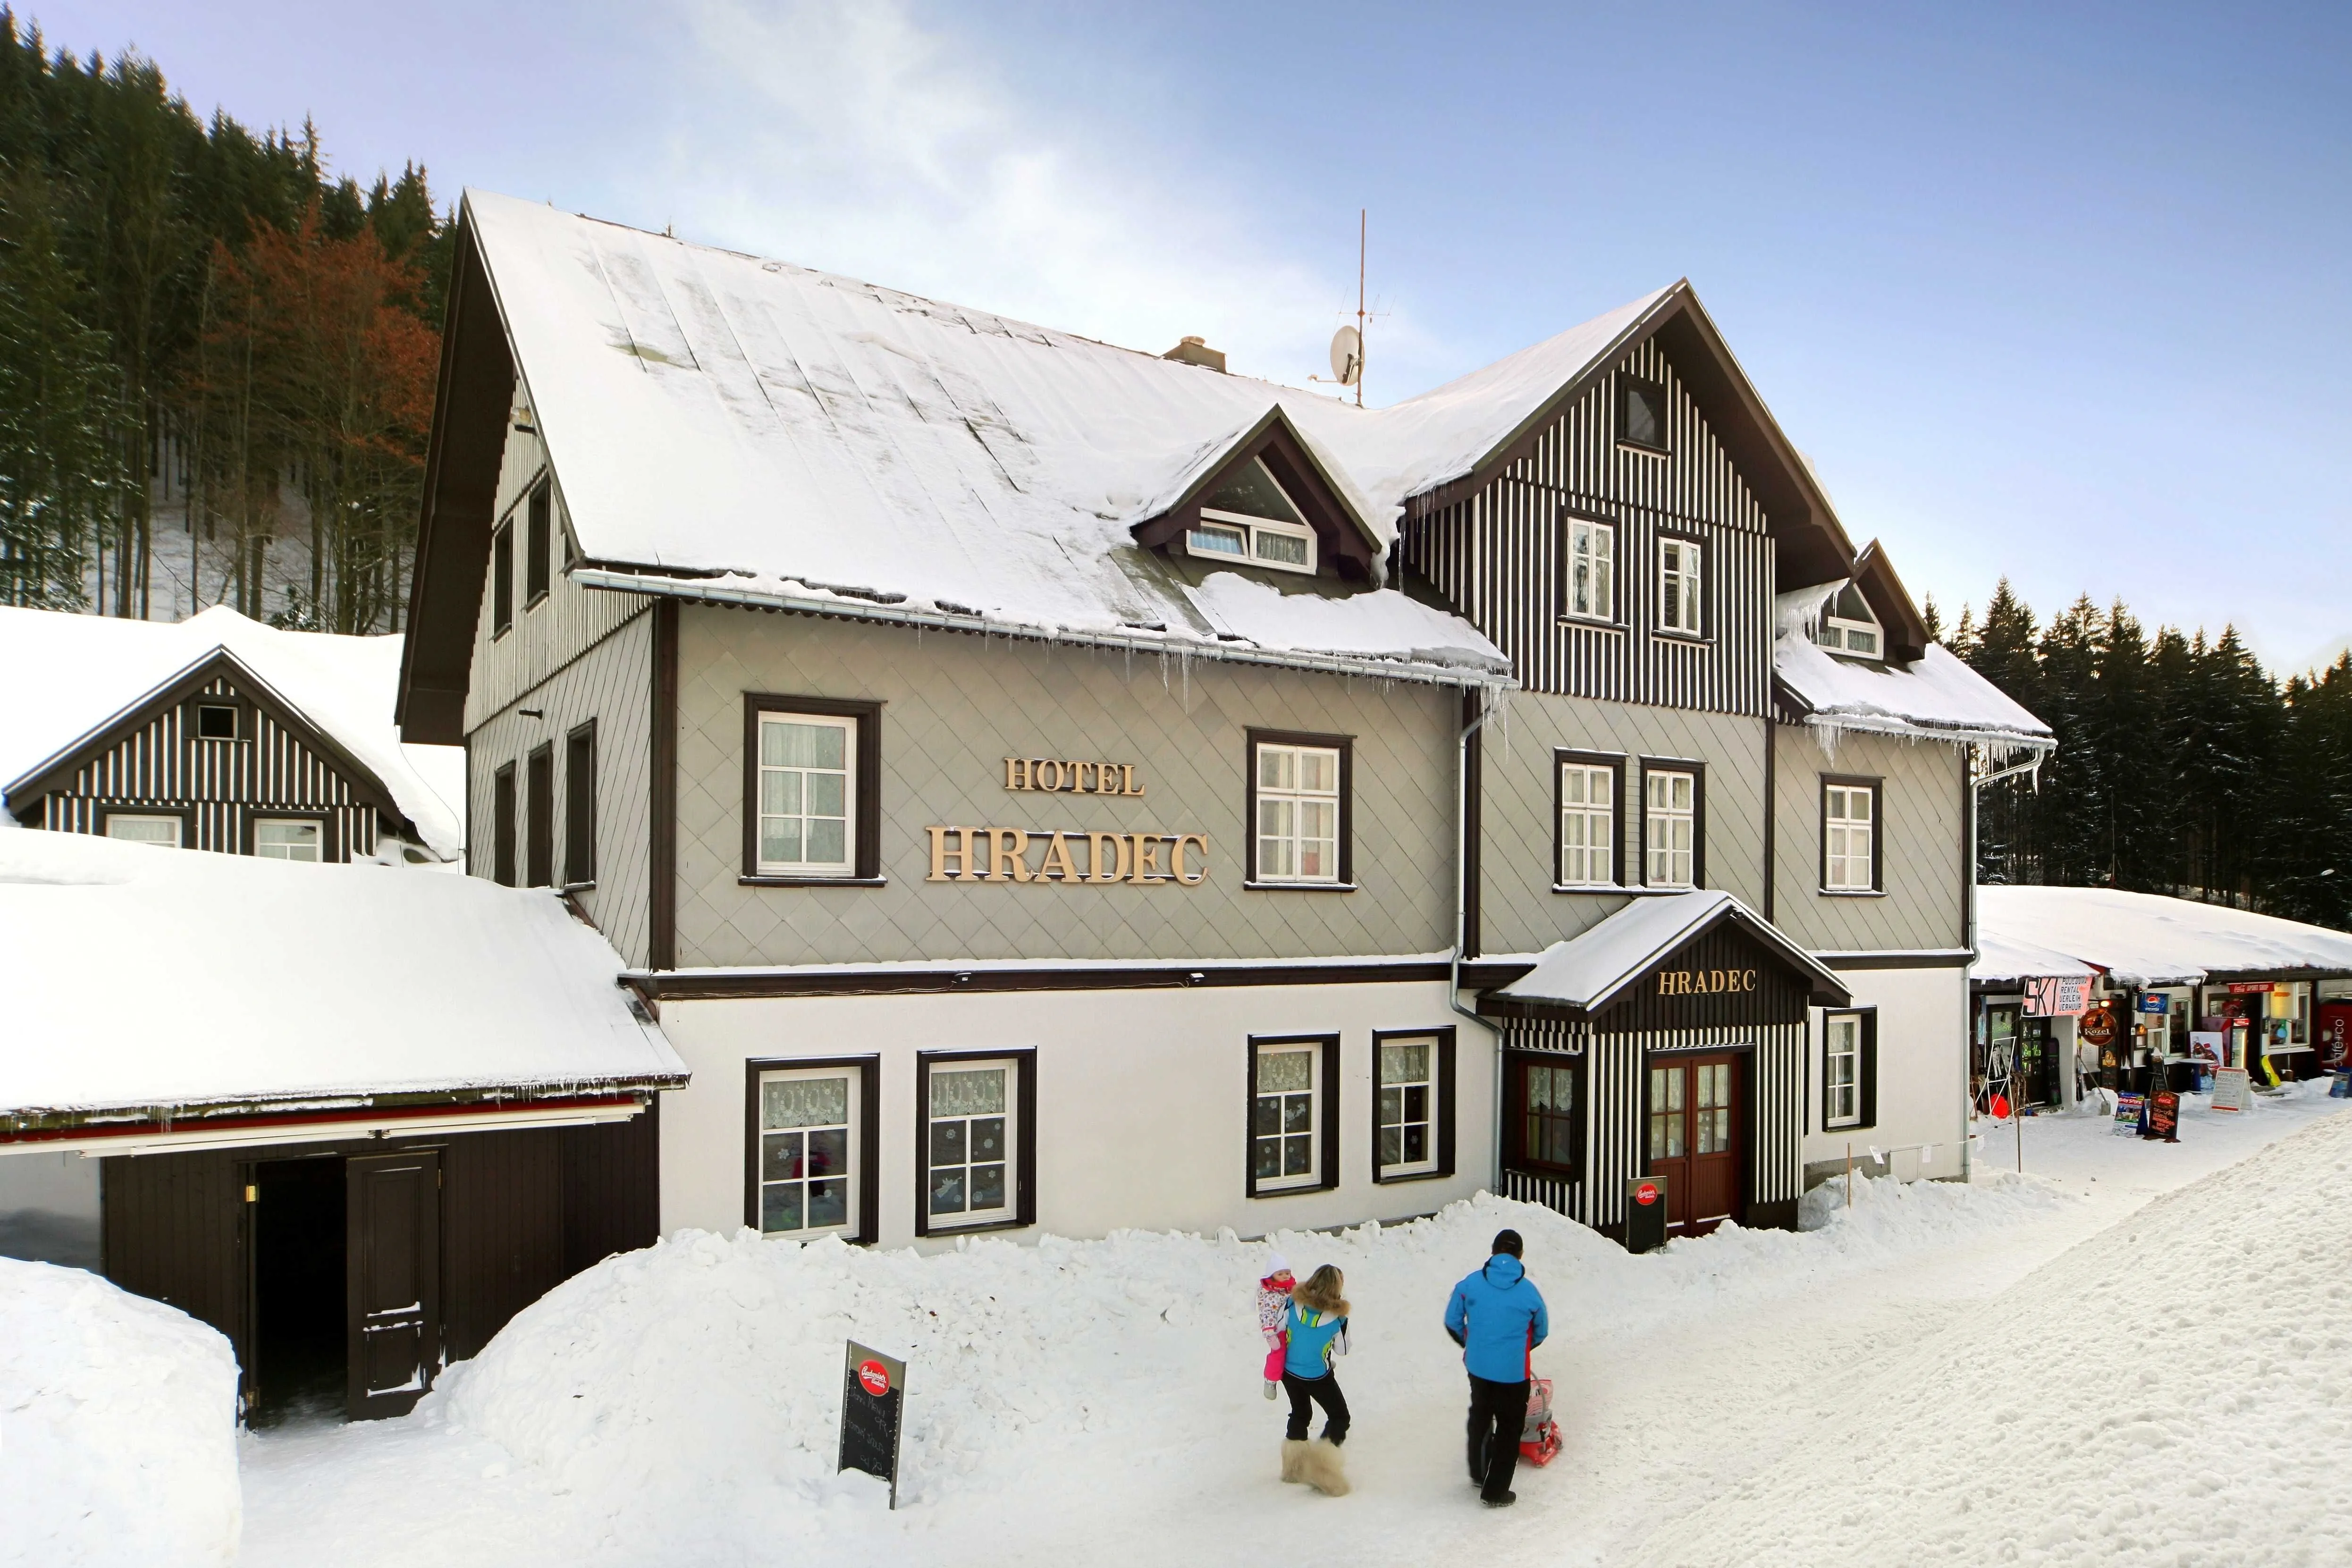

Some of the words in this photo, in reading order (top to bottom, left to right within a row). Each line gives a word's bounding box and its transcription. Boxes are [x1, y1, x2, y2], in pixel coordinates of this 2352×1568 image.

[1004, 757, 1145, 796] HOTEL
[925, 826, 1208, 886] HRADEC
[1658, 969, 1756, 995] HRADEC
[2022, 977, 2058, 1016] SKI
[2084, 1028, 2111, 1036] Kozel
